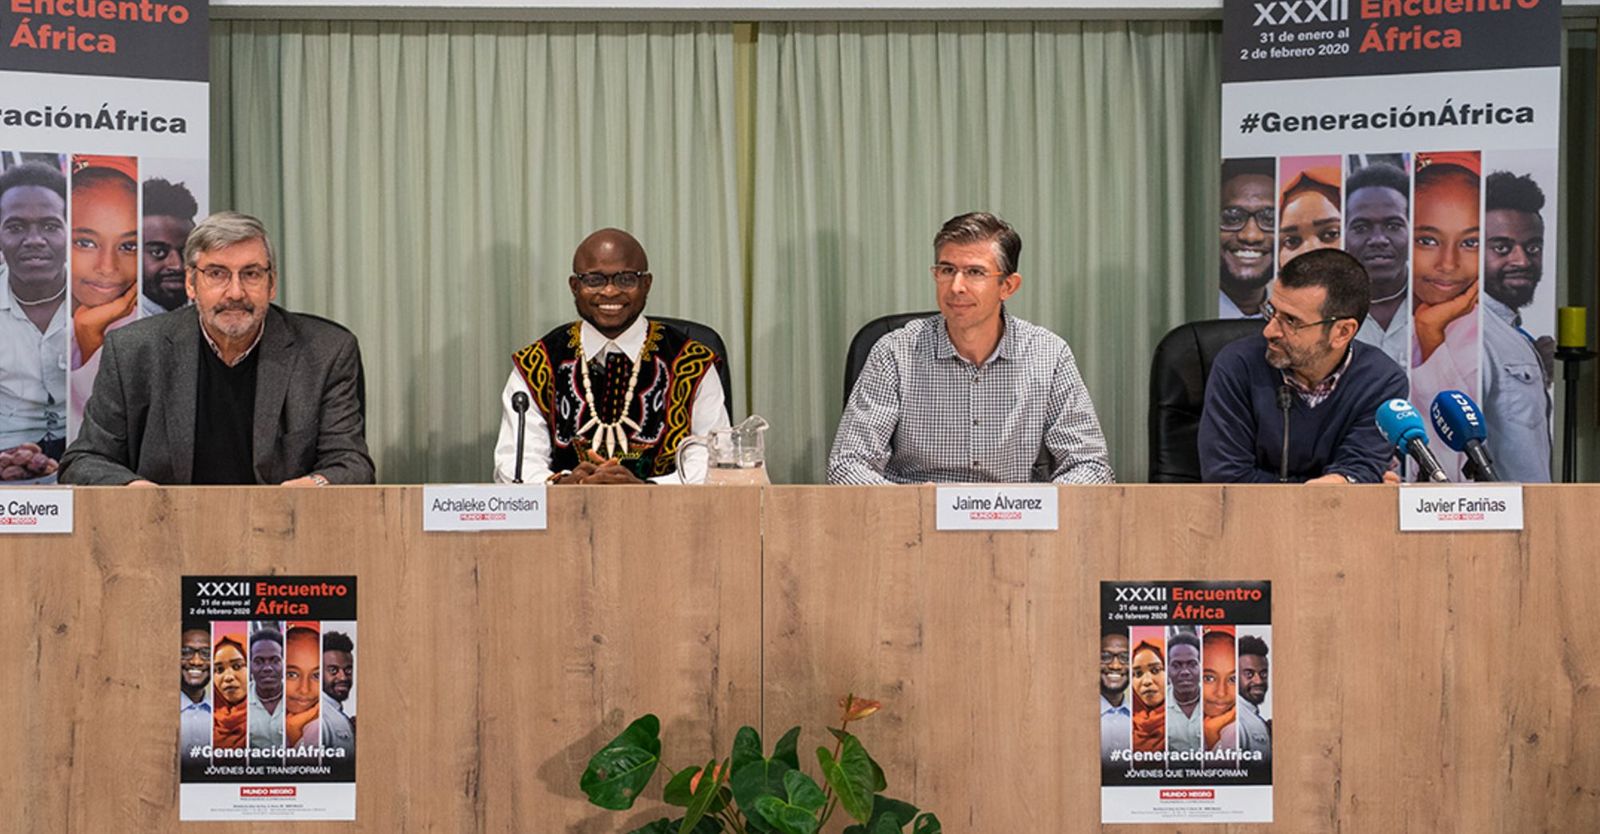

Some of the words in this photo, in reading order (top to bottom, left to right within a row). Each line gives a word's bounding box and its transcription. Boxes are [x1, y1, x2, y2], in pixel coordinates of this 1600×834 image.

[11, 0, 190, 24] Encuentro
[1252, 0, 1349, 26] XXXII
[10, 17, 117, 54] África
[1260, 32, 1275, 43] 31
[1278, 31, 1295, 42] de
[1297, 30, 1334, 41] enero
[1337, 27, 1350, 39] al
[1359, 22, 1462, 53] África
[1240, 48, 1249, 60] 2
[1251, 48, 1267, 59] de
[1270, 46, 1315, 58] febrero
[1318, 43, 1350, 56] 2020
[0, 102, 187, 134] aciónÁfrica
[1239, 98, 1535, 134] #GeneraciónÁfrica
[8, 500, 59, 516] Calvera
[432, 498, 486, 512] Achaleke
[488, 497, 539, 512] Christian
[952, 496, 991, 511] Jaime
[994, 491, 1043, 510] Álvarez
[1416, 498, 1456, 513] Javier
[1458, 498, 1507, 512] Fariñas
[196, 582, 250, 597] XXXII
[255, 582, 347, 597] Encuentro
[1115, 587, 1167, 601] XXXII
[1172, 587, 1262, 601] Encuentro
[255, 598, 309, 615] África
[1172, 603, 1225, 619] África
[1114, 612, 1124, 620] de
[190, 743, 346, 759] #GeneraciónÁfrica
[1110, 747, 1263, 762] #GeneraciónÁfrica
[204, 765, 244, 775] JÓVENES
[246, 766, 265, 775] QUE
[267, 766, 331, 775] TRANSFORMAN
[1124, 768, 1163, 778] JÓVENES
[1165, 769, 1184, 778] QUE
[1185, 768, 1249, 777] TRANSFORMAN
